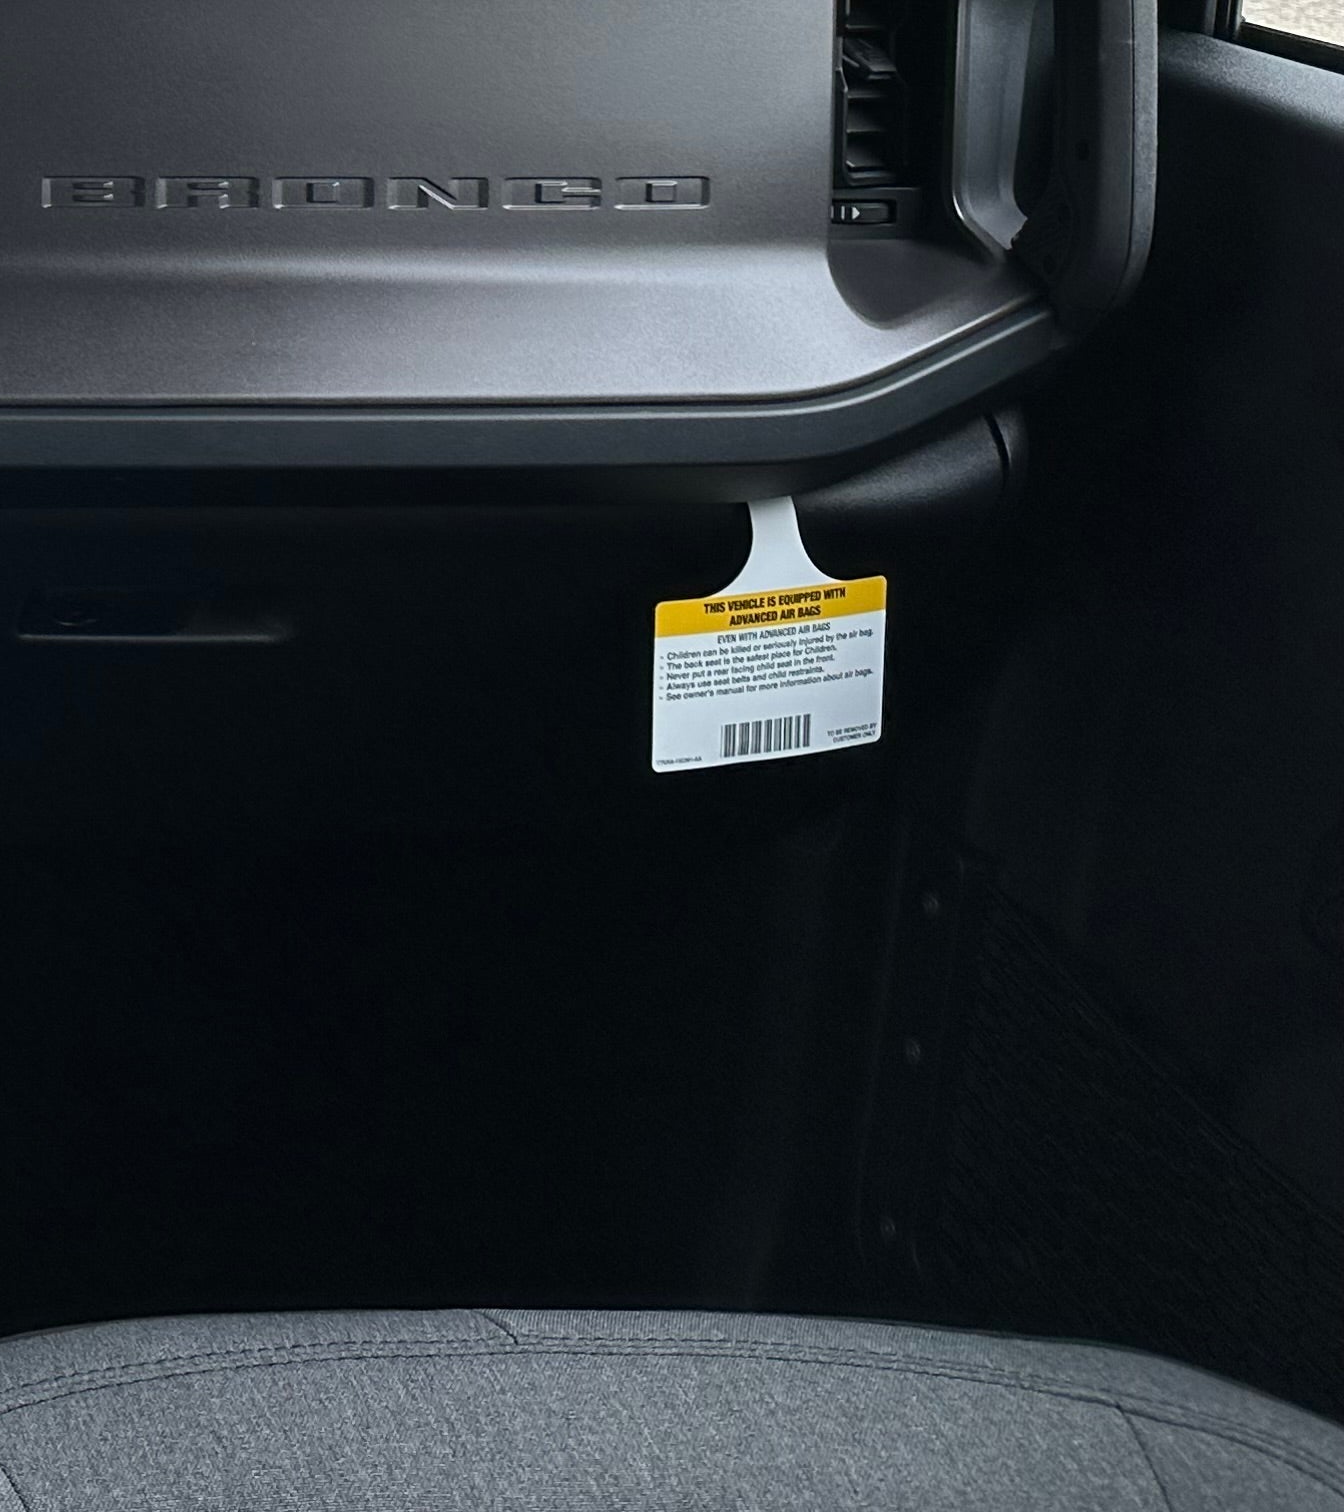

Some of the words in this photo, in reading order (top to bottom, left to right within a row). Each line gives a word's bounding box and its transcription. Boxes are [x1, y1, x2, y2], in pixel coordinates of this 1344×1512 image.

[40, 175, 710, 211] BRONCO
[704, 602, 726, 614] THIS
[728, 598, 765, 611] VEHICLE
[767, 596, 776, 607] IS
[779, 591, 821, 605] EQUIPPED
[824, 587, 846, 600] WITH
[729, 610, 777, 626] ADVANCED
[780, 609, 796, 620] AIR
[798, 605, 821, 619] BAGS
[717, 634, 736, 644] EVEN
[738, 632, 758, 642] WITH
[759, 627, 796, 639] ADVANCED
[798, 625, 810, 634] AIR
[667, 650, 701, 661] Children
[667, 662, 682, 670] The
